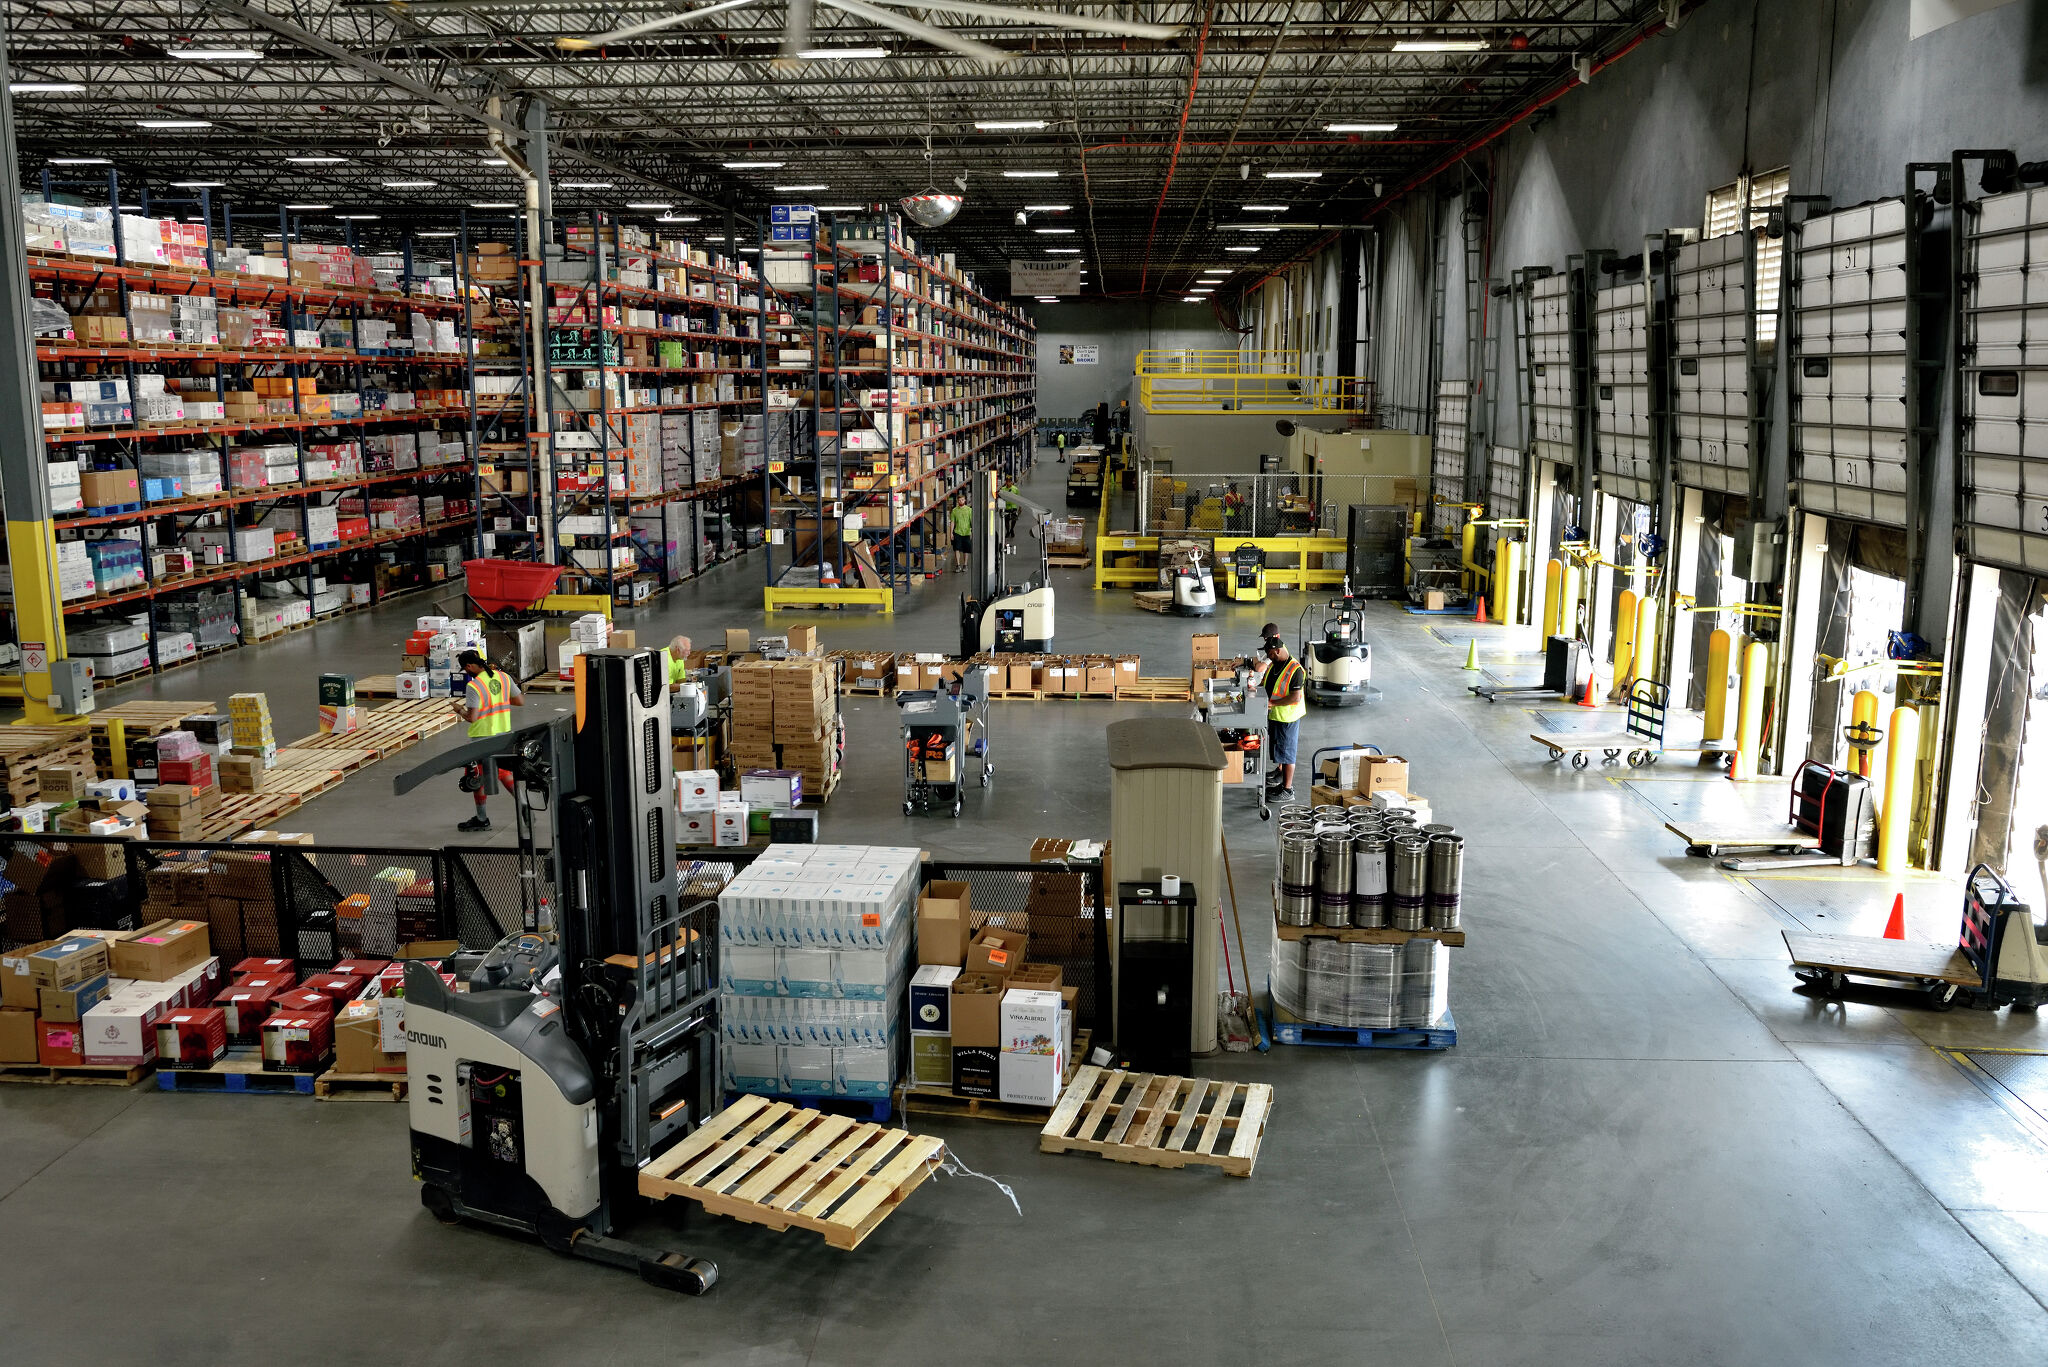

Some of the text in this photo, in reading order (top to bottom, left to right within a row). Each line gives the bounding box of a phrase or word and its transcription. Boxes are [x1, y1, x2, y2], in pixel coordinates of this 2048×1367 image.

[1845, 246, 1857, 269] 31
[1021, 262, 1071, 270] ATTITUDE
[1706, 269, 1716, 288] 32
[1619, 310, 1626, 327] 33
[1708, 444, 1717, 462] 32
[480, 466, 493, 474] 160
[591, 466, 601, 475] 161
[771, 462, 782, 471] 161
[875, 463, 887, 472] 162
[1622, 459, 1630, 476] 33
[1846, 462, 1858, 484] 31
[42, 784, 69, 792] ROOTS
[407, 1030, 447, 1050] CROWN
[956, 1049, 977, 1057] VILLA
[978, 1049, 997, 1061] POZZI
